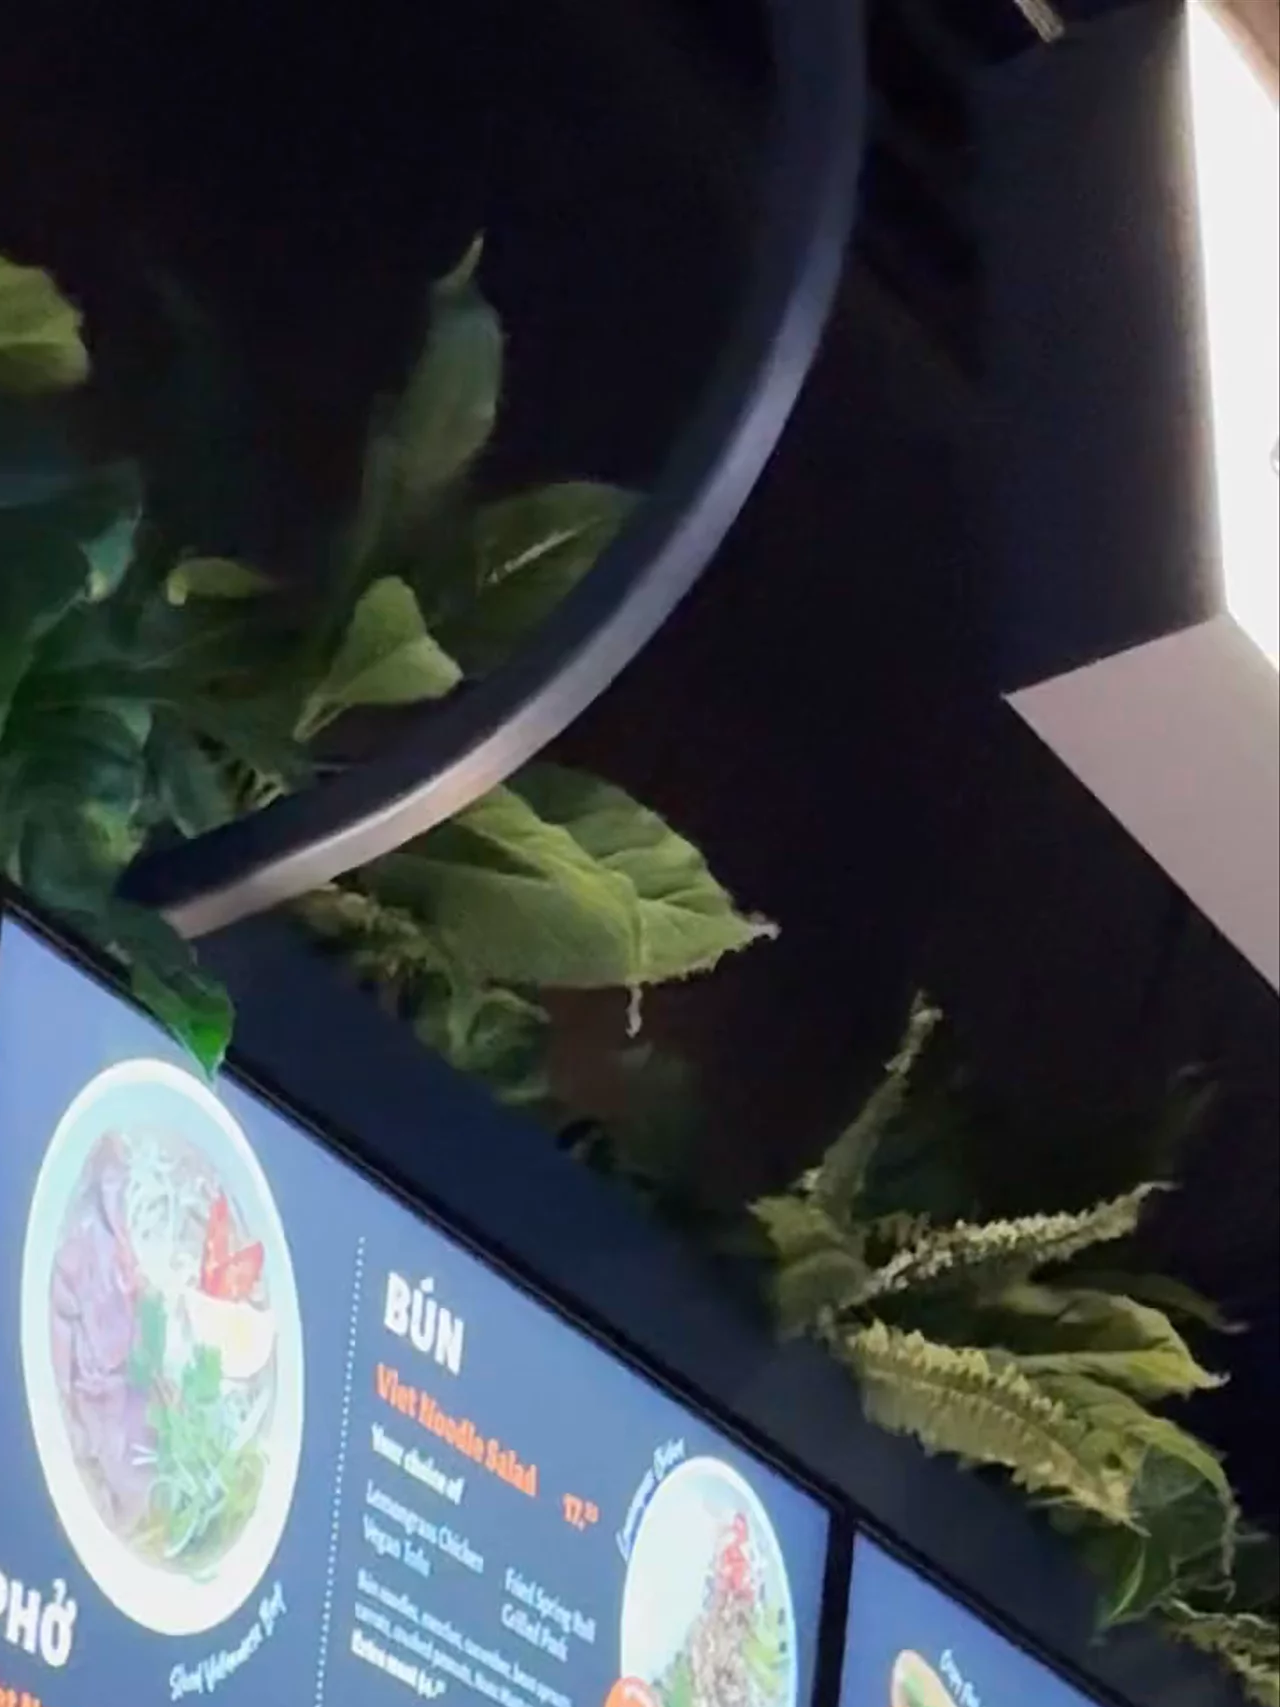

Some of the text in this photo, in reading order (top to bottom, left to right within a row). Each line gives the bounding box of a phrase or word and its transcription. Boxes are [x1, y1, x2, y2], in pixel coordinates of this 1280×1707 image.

[384, 1273, 463, 1374] BÚN
[378, 1364, 536, 1495] Viet Noodle Salad
[364, 1515, 430, 1576] Vegan Tofu
[366, 1480, 483, 1572] Lemongrass Chicken
[506, 1568, 535, 1605] Fried
[536, 1588, 573, 1633] Spring
